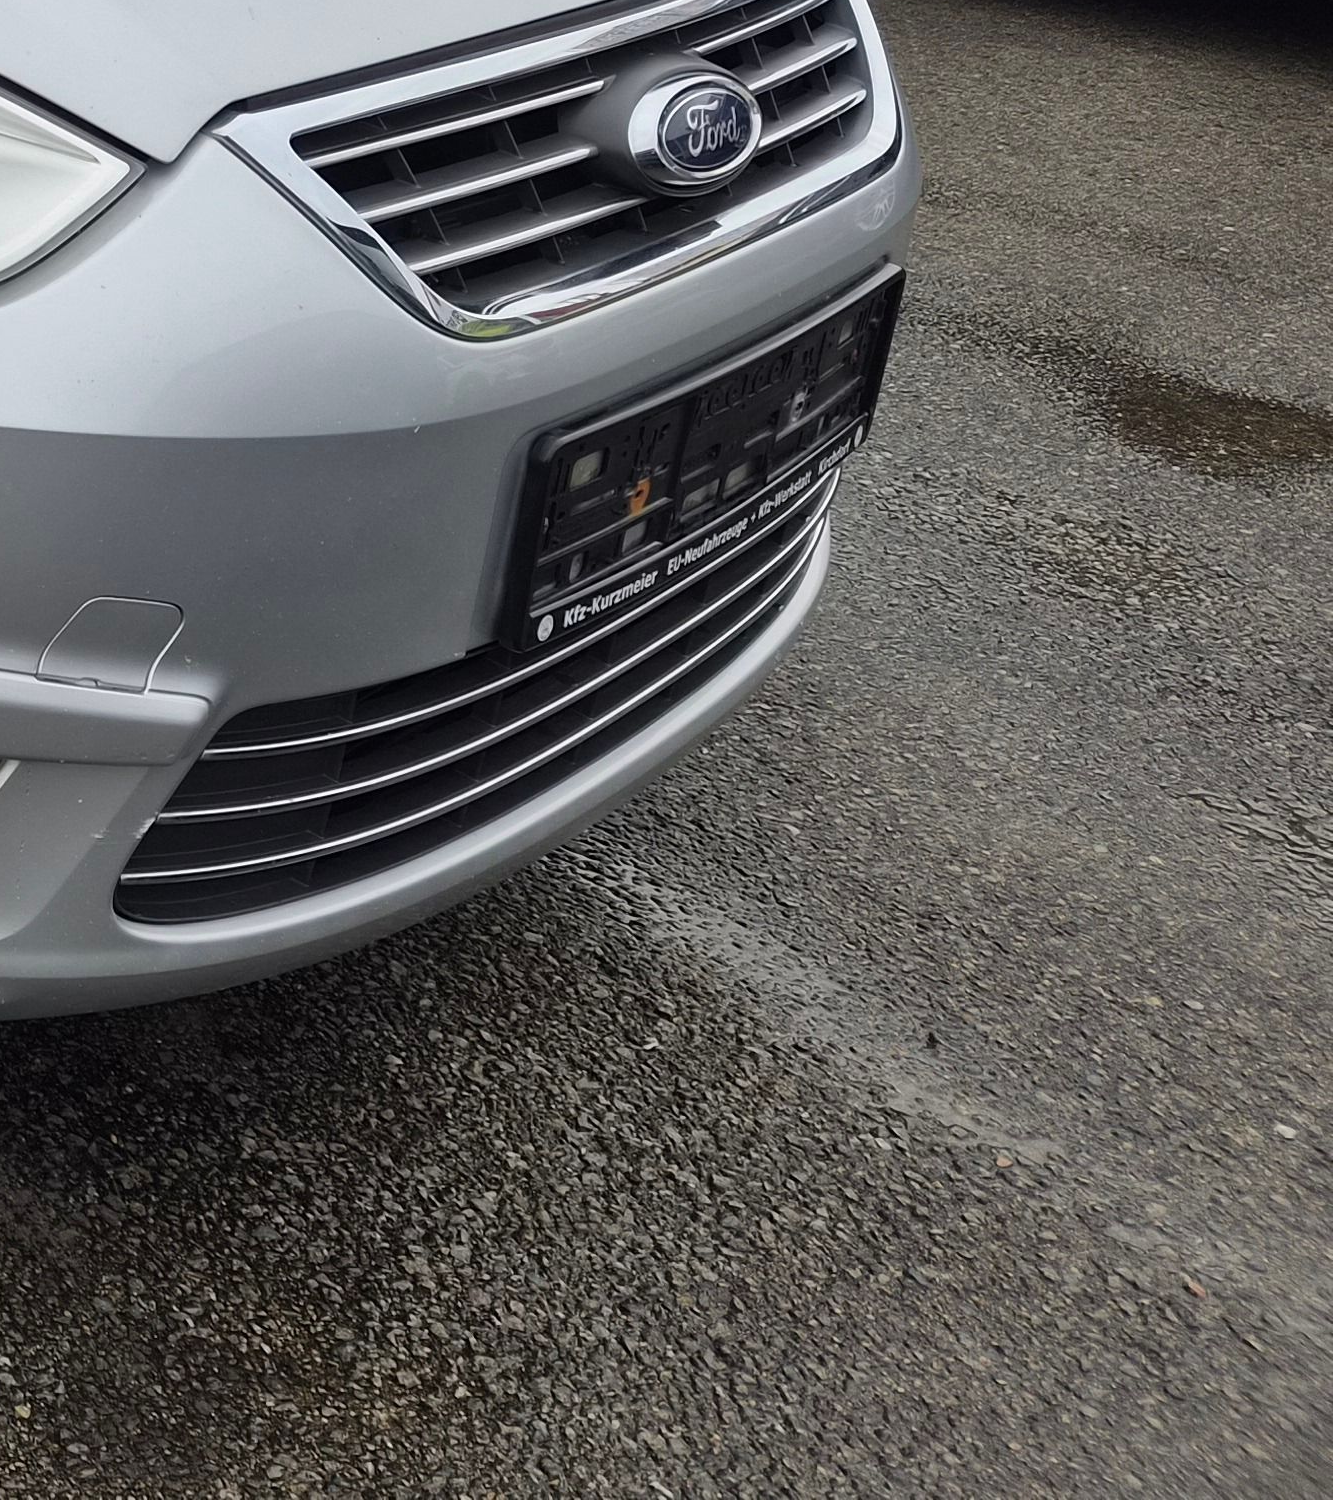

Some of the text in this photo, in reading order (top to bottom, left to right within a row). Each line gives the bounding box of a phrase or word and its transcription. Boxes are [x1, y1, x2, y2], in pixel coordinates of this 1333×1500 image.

[687, 99, 741, 158] Ford
[563, 569, 659, 629] Kfz-Kurzmeier
[666, 516, 748, 576] EU-Neufahrzeuge
